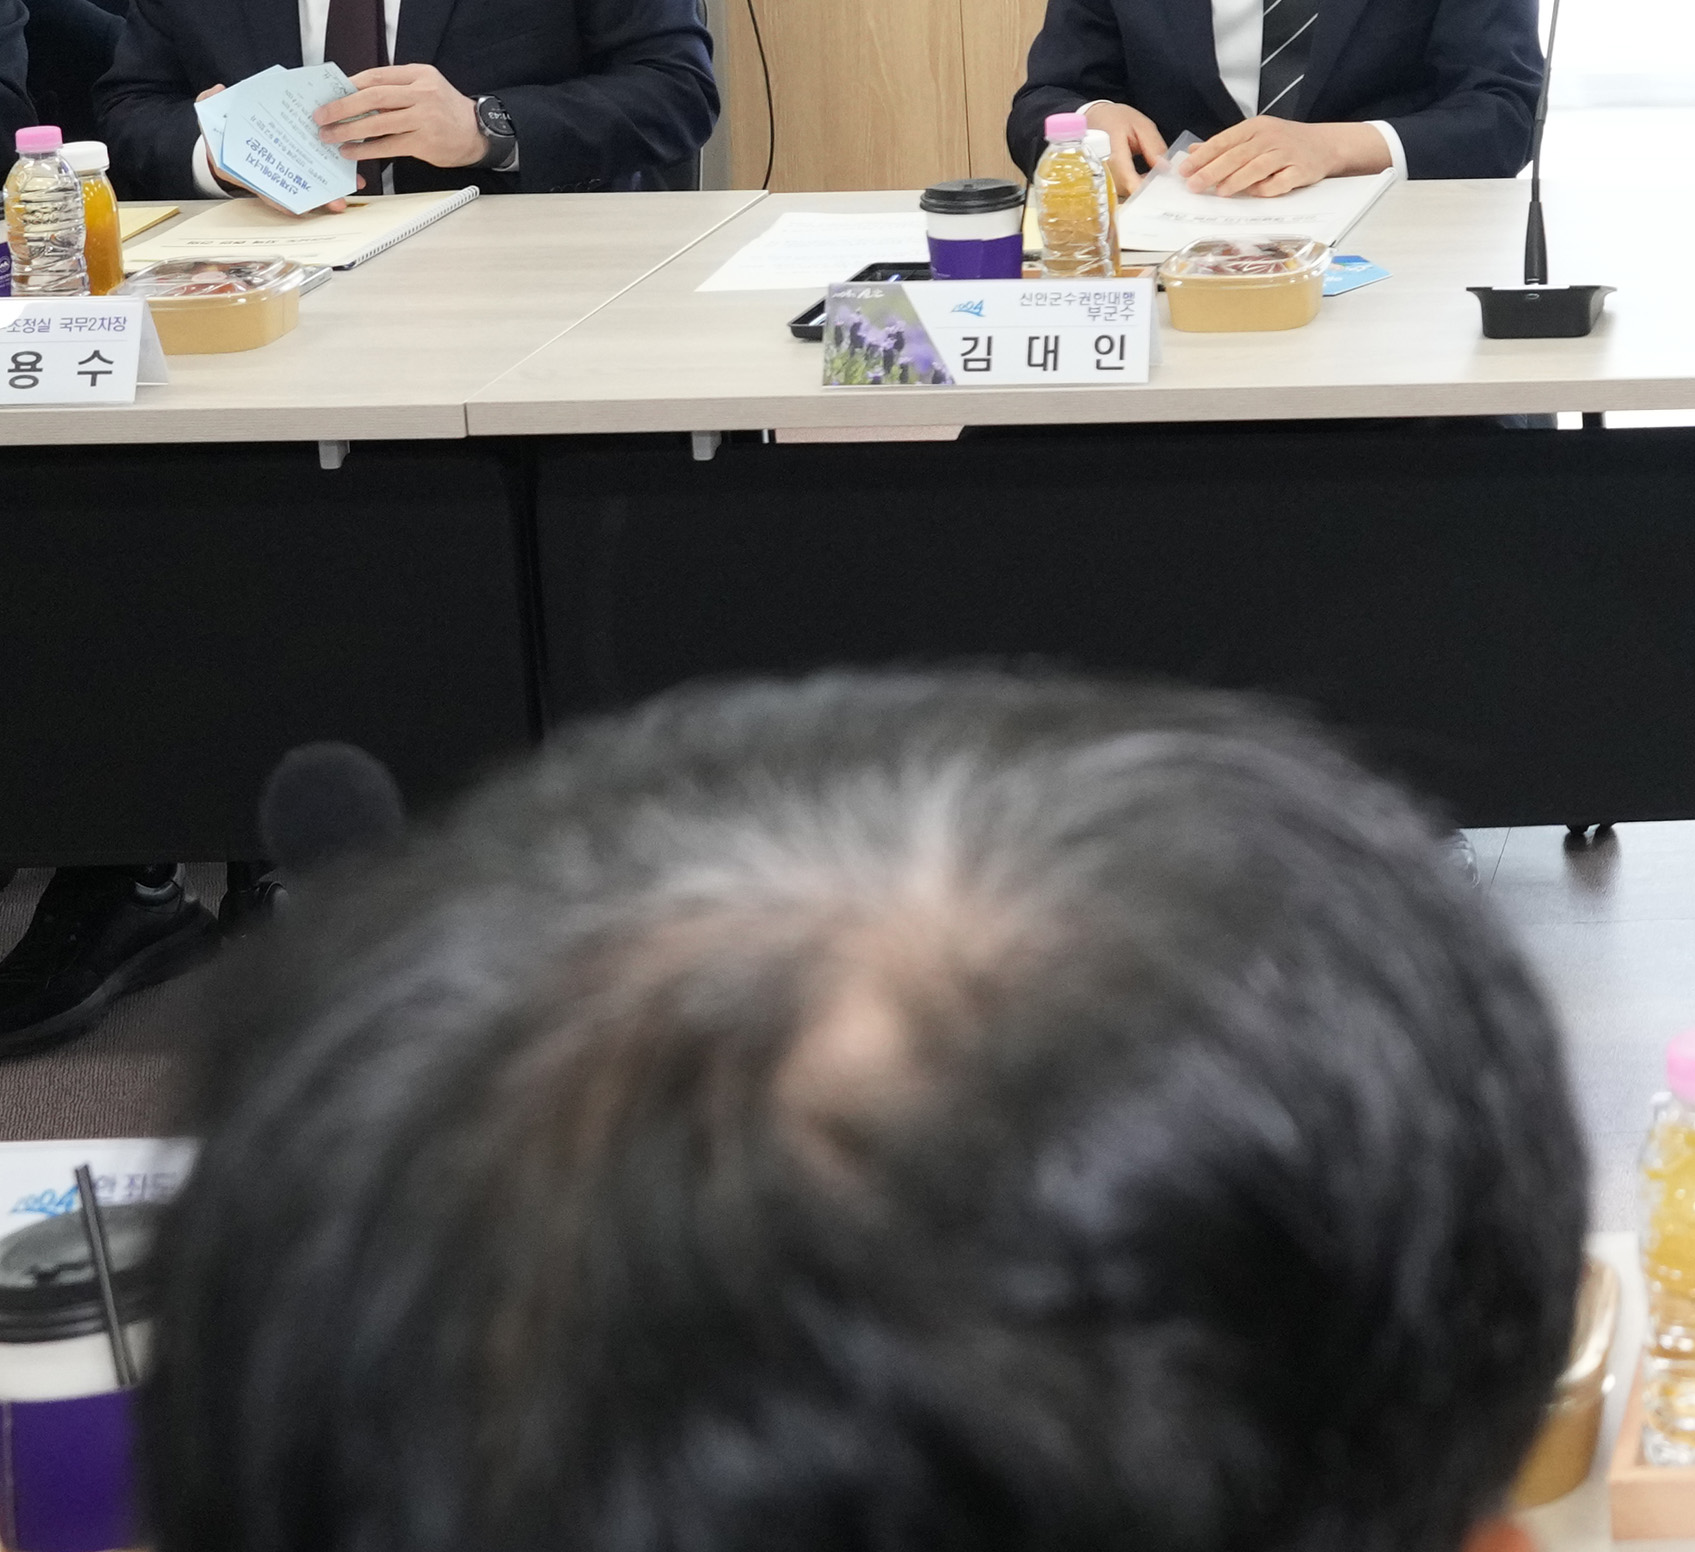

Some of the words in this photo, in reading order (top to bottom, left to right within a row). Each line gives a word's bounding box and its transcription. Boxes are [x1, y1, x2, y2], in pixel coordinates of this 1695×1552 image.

[1020, 292, 1136, 307] 신안군수권한대행
[1087, 306, 1136, 322] 부군수
[59, 316, 128, 333] 국무2차장
[7, 350, 44, 390] 용
[77, 349, 115, 388] 수
